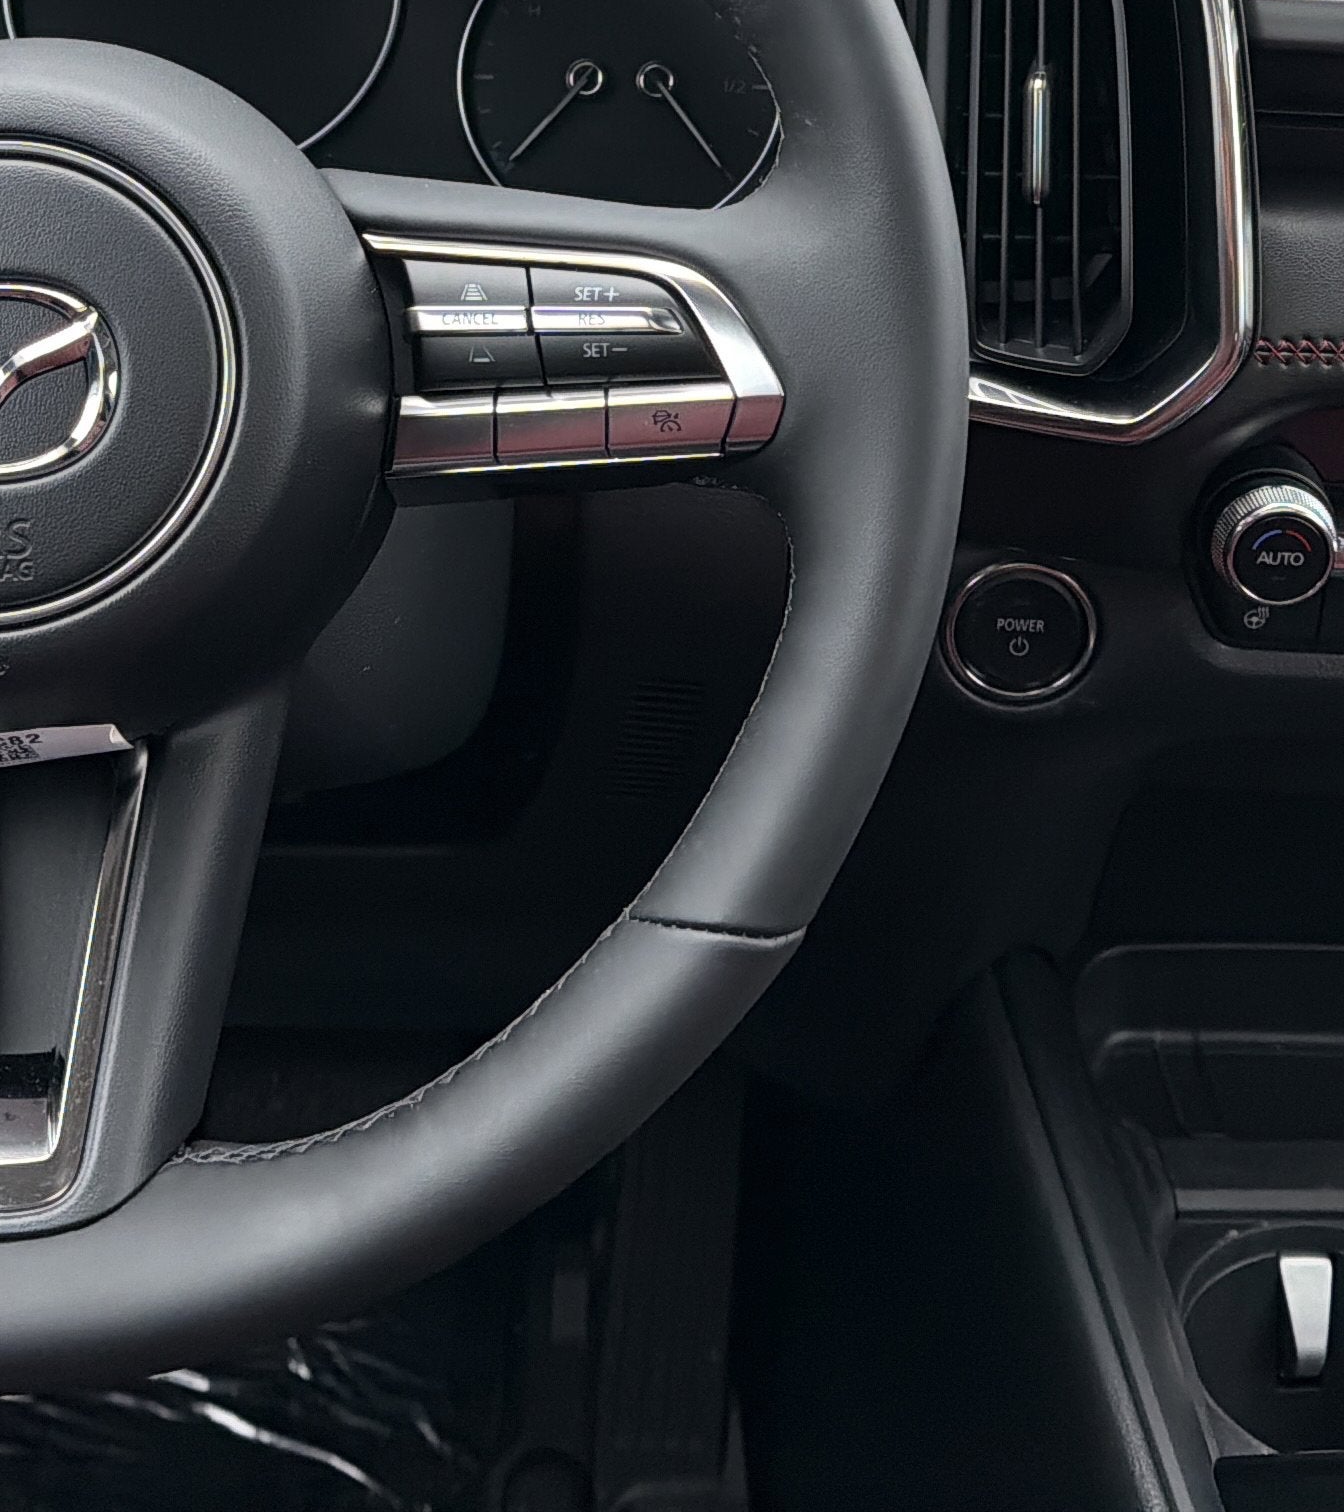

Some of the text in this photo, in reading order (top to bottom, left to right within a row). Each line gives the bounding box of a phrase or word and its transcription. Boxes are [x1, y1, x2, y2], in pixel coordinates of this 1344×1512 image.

[441, 310, 499, 326] CANCEL
[578, 311, 606, 326] RES
[1256, 551, 1305, 567] AUTO
[996, 617, 1045, 633] POWER
